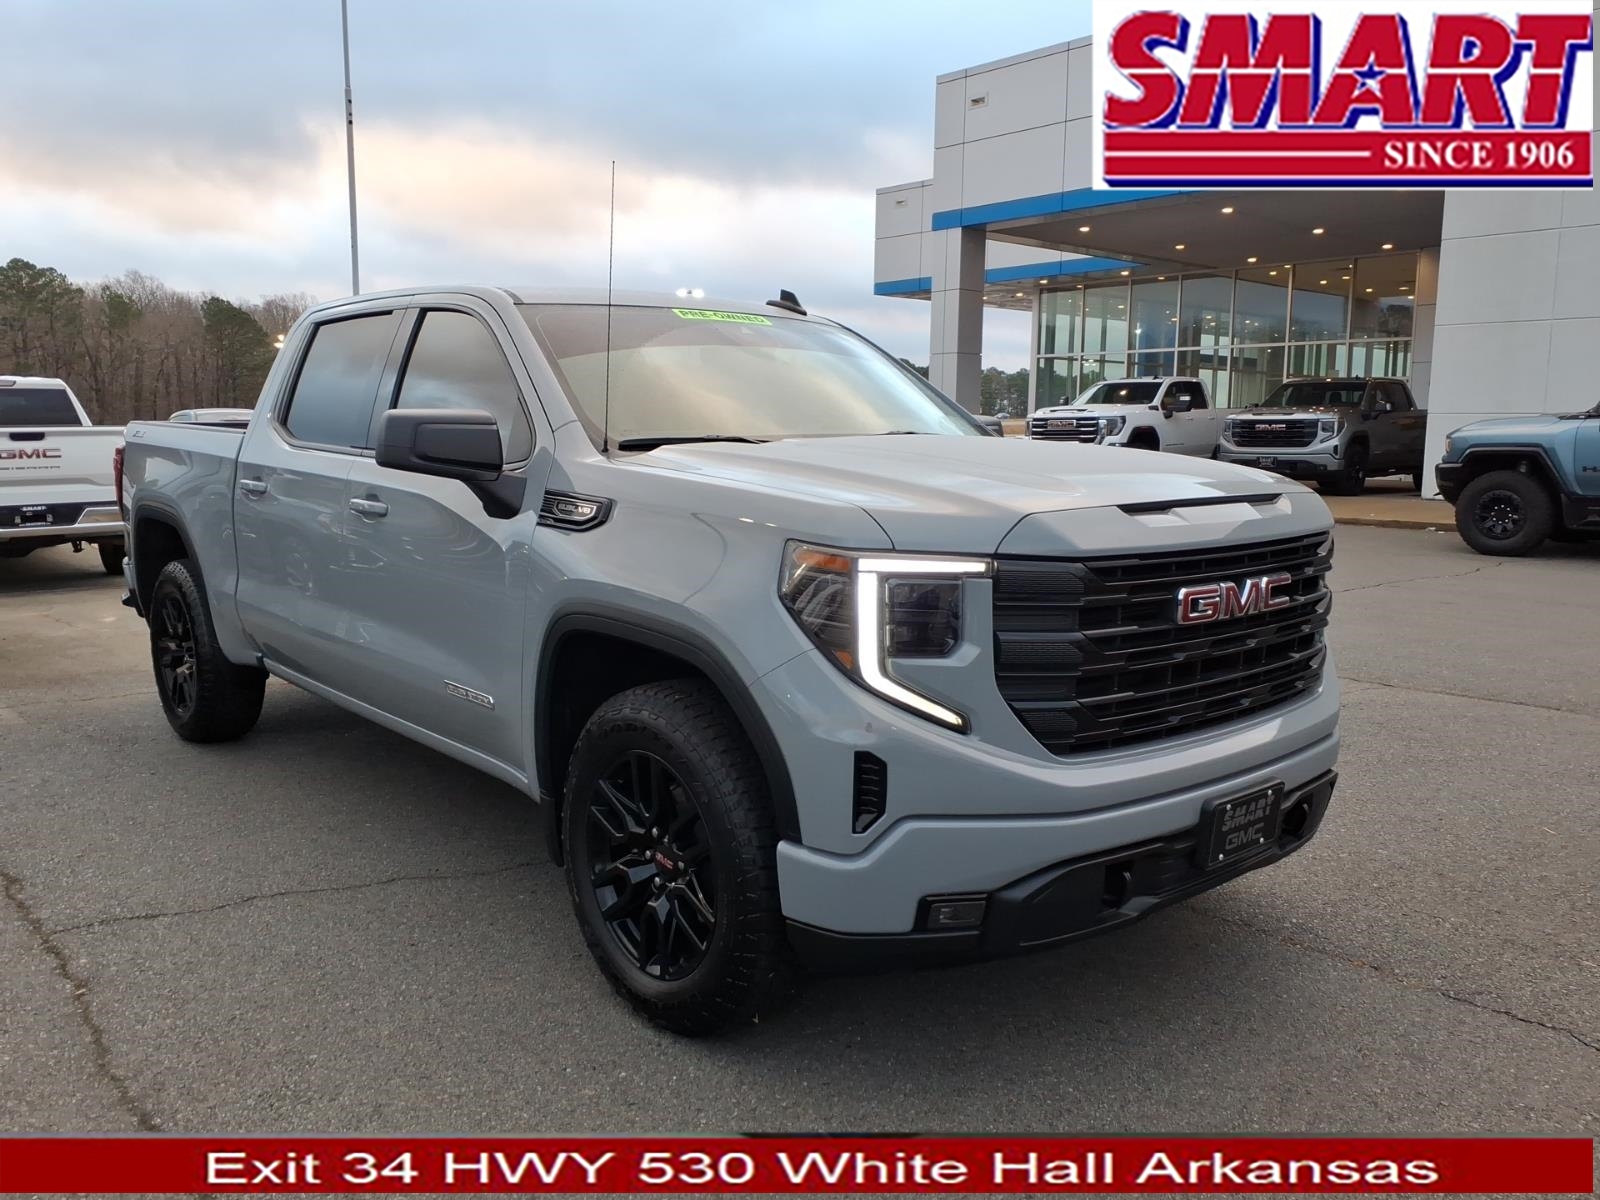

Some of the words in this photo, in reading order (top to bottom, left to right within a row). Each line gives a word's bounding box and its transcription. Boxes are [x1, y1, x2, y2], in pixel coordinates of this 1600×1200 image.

[680, 310, 765, 323] PRE-OWNED
[0, 448, 62, 459] GMC
[1178, 572, 1291, 624] GMC
[1222, 795, 1275, 831] SMART
[1225, 822, 1264, 850] GMC
